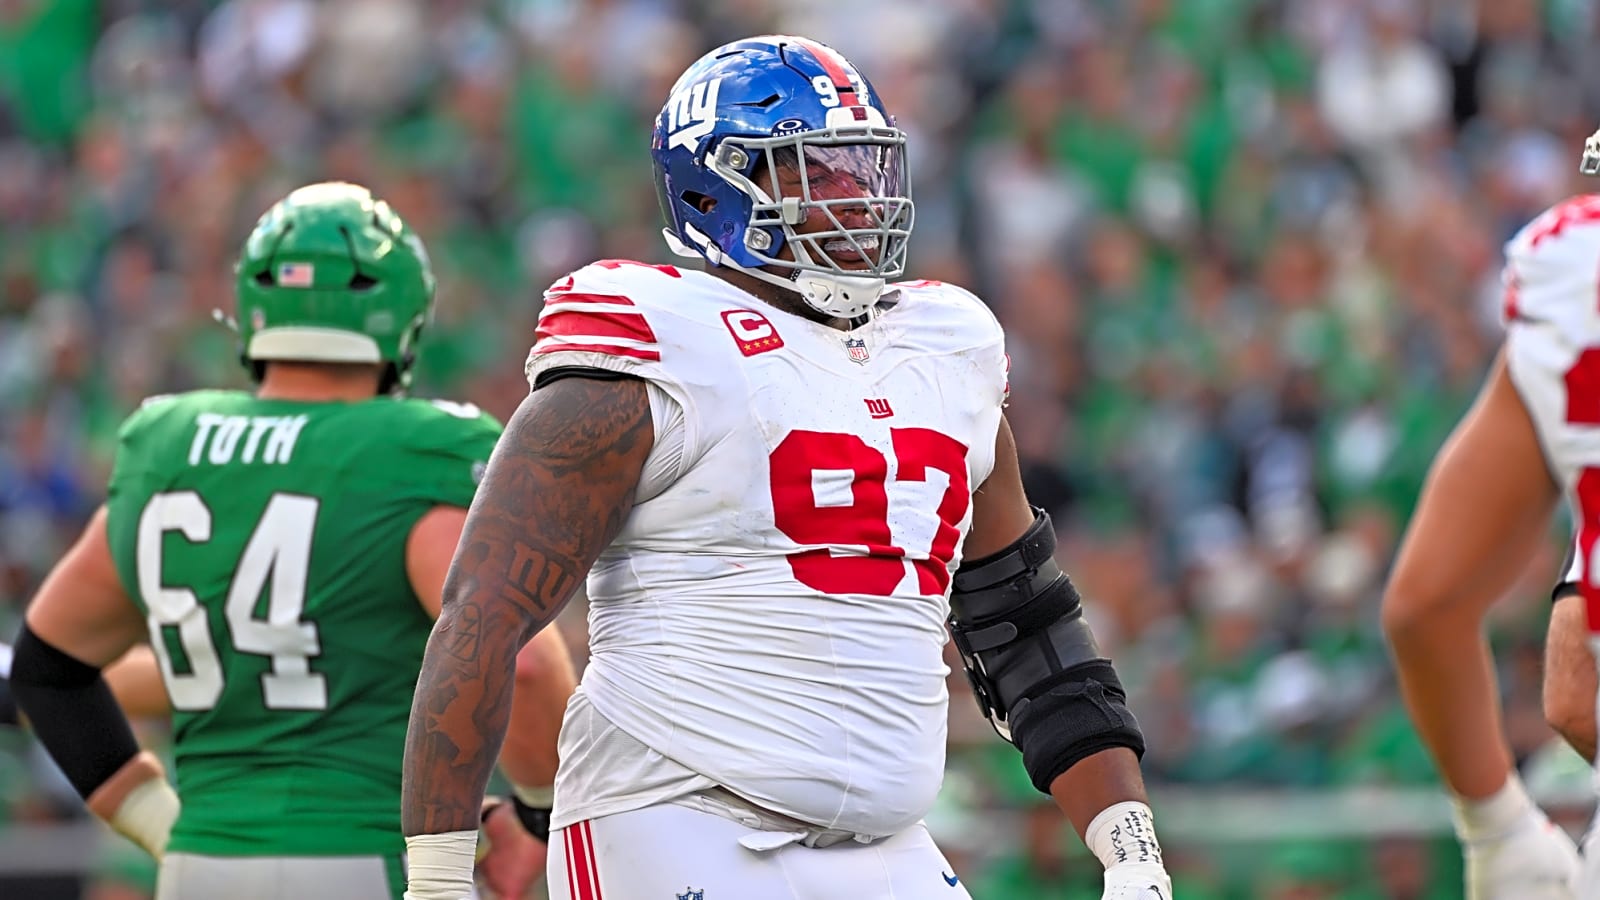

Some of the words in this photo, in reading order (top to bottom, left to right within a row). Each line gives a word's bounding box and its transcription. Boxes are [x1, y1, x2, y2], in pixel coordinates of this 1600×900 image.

[726, 312, 773, 342] C
[849, 347, 869, 359] NFL
[188, 412, 309, 466] TOTH
[769, 427, 970, 596] 97
[136, 489, 328, 712] 64
